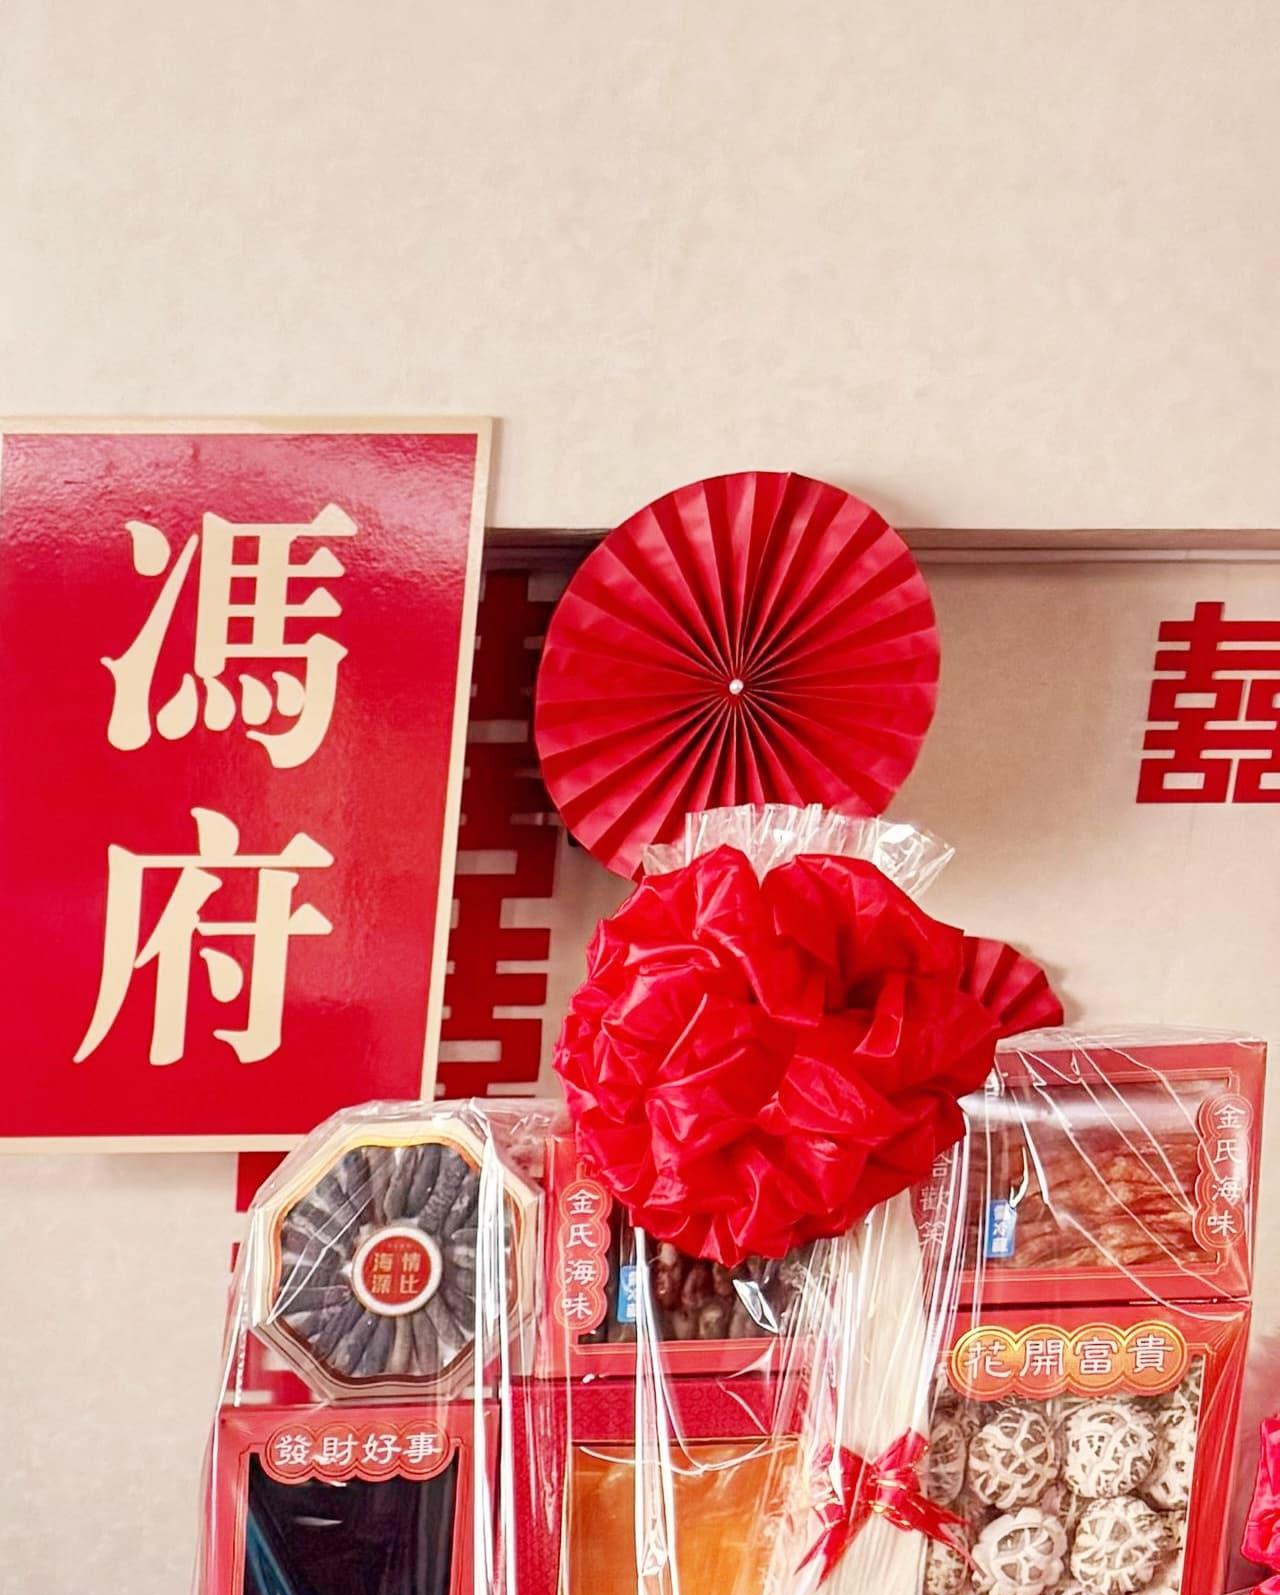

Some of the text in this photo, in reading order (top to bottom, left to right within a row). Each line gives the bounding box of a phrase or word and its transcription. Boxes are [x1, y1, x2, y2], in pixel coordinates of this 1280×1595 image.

[73, 503, 358, 1067] 馮府
[1206, 1103, 1248, 1238] 金氏海味
[561, 1187, 599, 1320] 金氏海味
[965, 1336, 1175, 1380] 花開富貴
[274, 1432, 441, 1466] 發財好事
